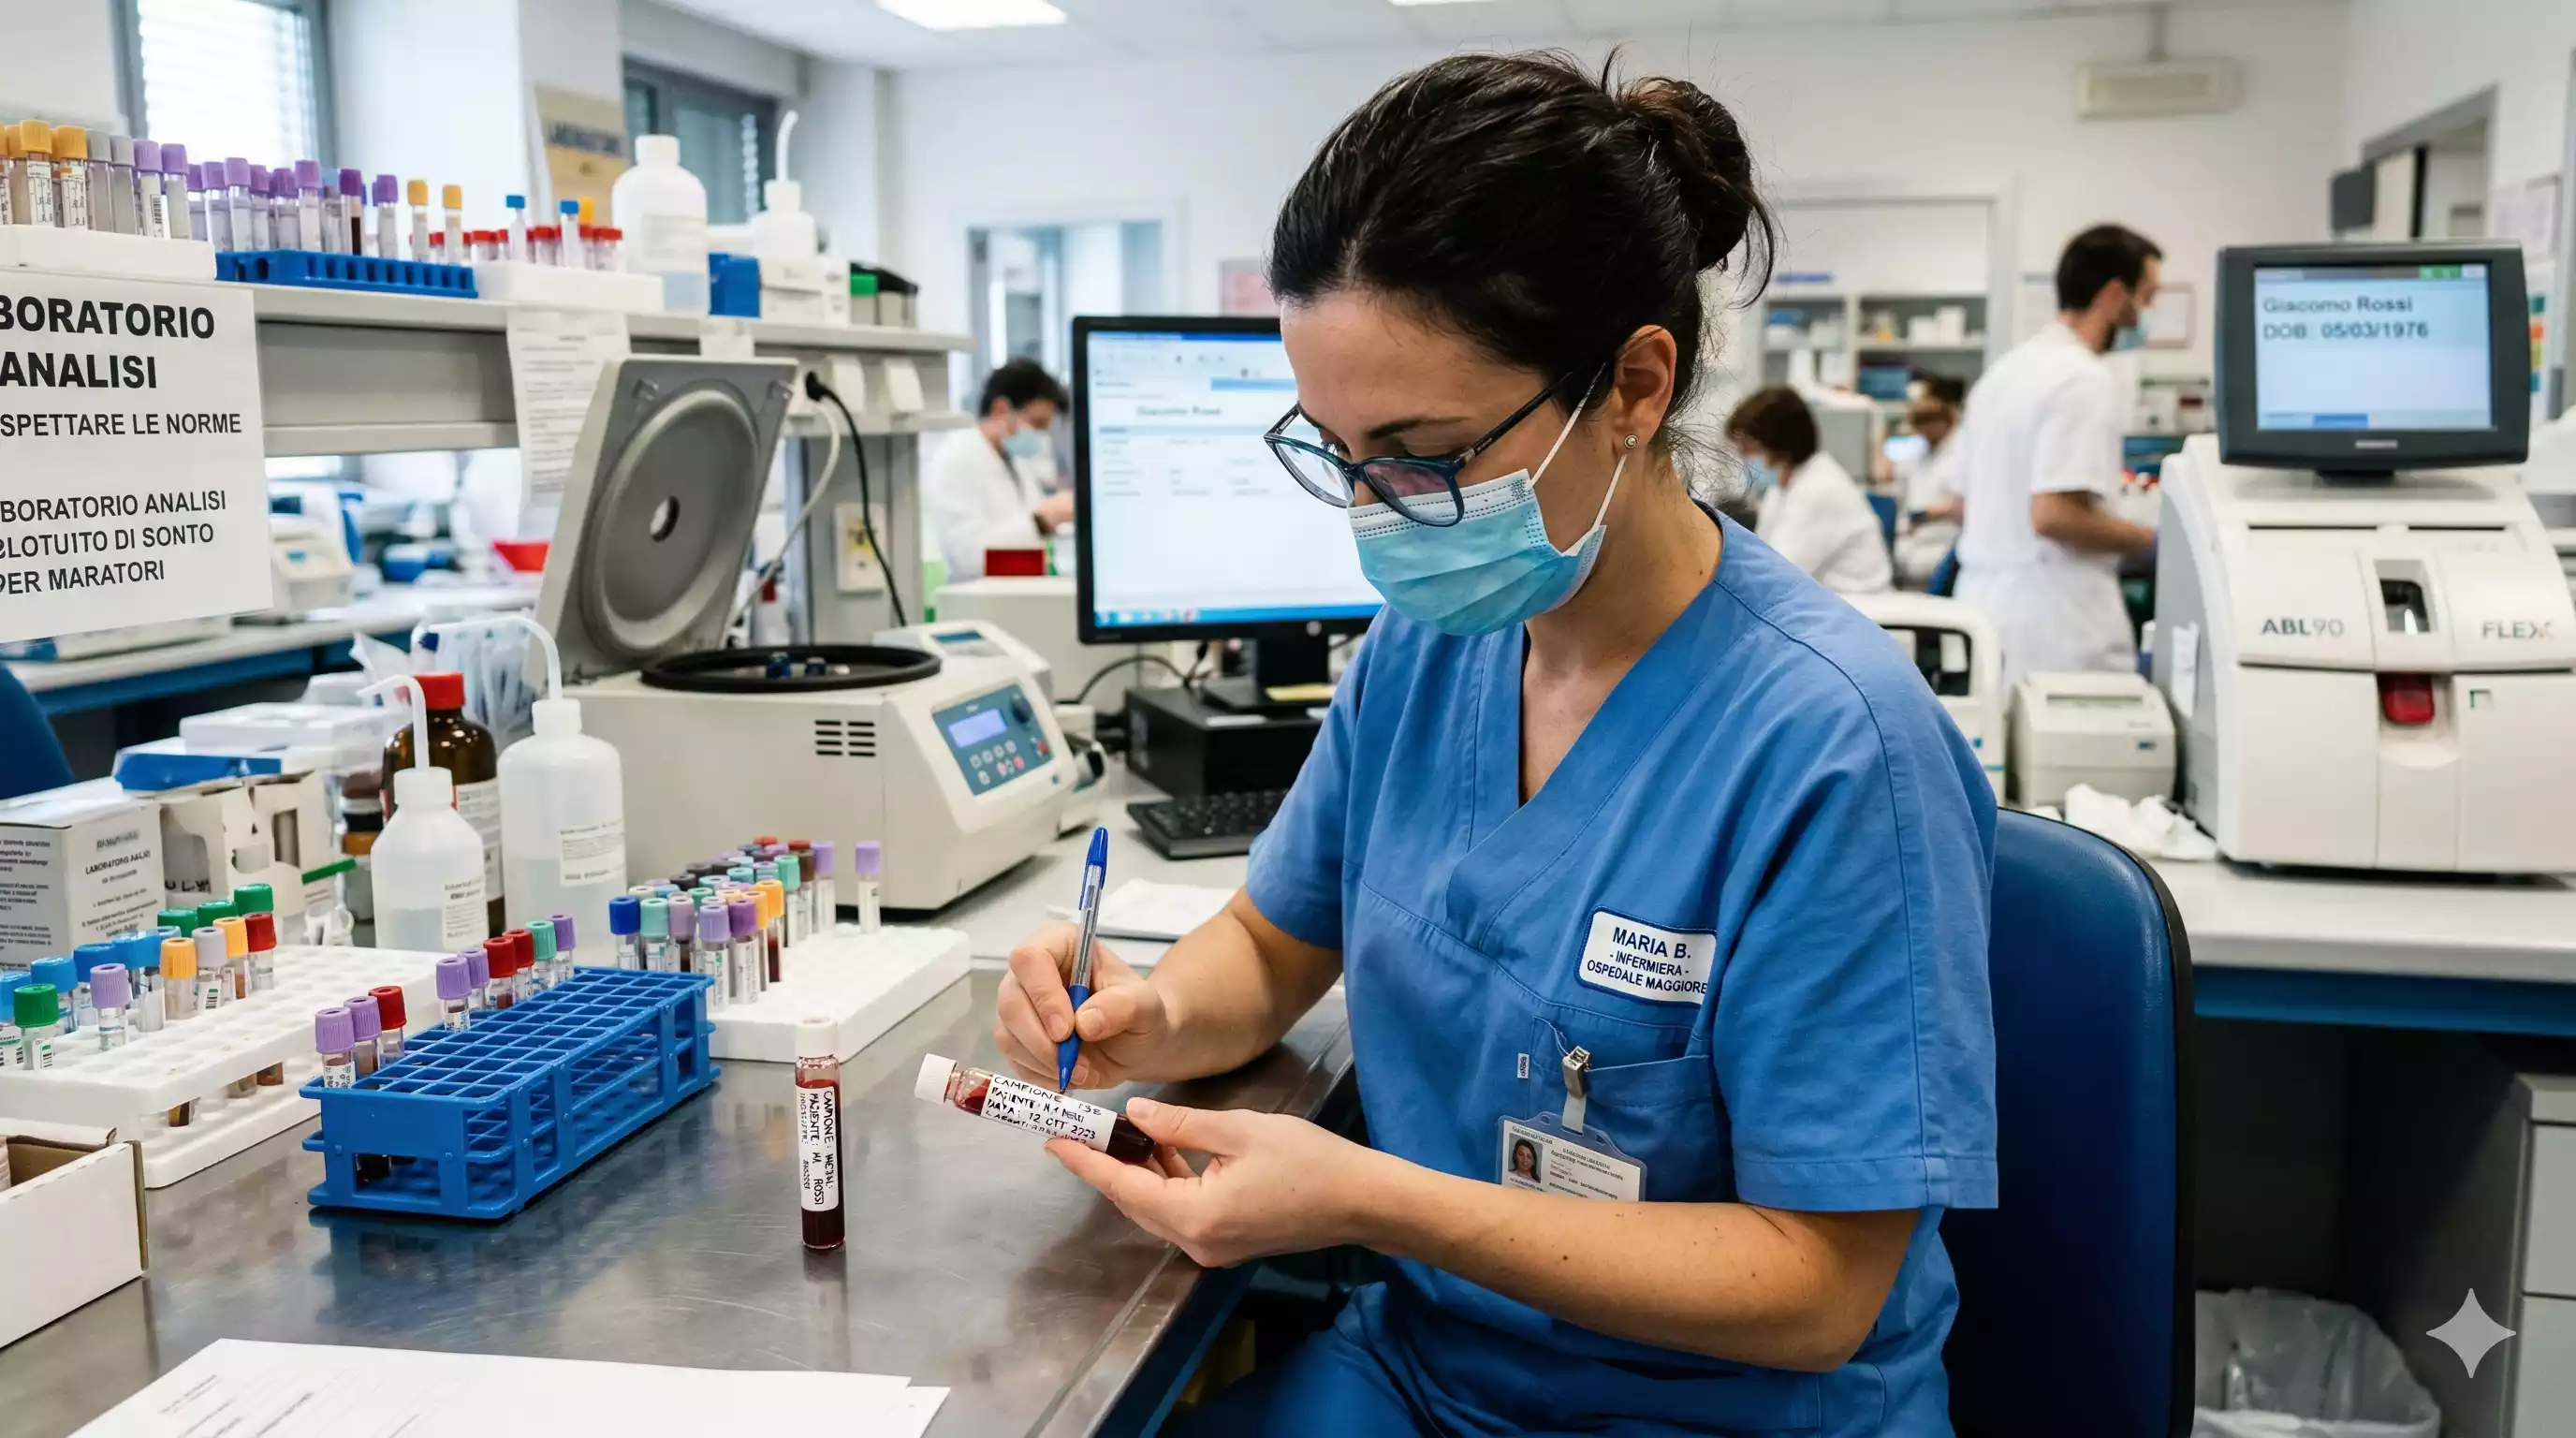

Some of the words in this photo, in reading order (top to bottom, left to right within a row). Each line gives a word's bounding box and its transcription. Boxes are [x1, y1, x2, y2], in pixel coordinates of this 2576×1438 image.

[2263, 297, 2351, 314] Giacomo
[2356, 296, 2413, 312] Rossi
[2321, 321, 2429, 339] 05/03/1976
[0, 351, 157, 389] ANALISI
[0, 413, 125, 437] SPETTARE
[132, 413, 160, 435] LE
[167, 413, 242, 434] NORME
[0, 494, 139, 522] BORATORIO
[145, 490, 227, 514] ANALISI
[115, 528, 136, 550] DI
[142, 522, 214, 548] SONTO
[48, 560, 165, 591] MARATORI
[2261, 617, 2345, 636] ABL90
[1612, 926, 1668, 958] MARIA
[1674, 943, 1691, 959] B.
[1616, 950, 1682, 976] INFERMIERA
[1587, 960, 1644, 986] OSPEDALE
[1646, 976, 1707, 994] MAGGIORE
[1029, 1111, 1041, 1123] 12
